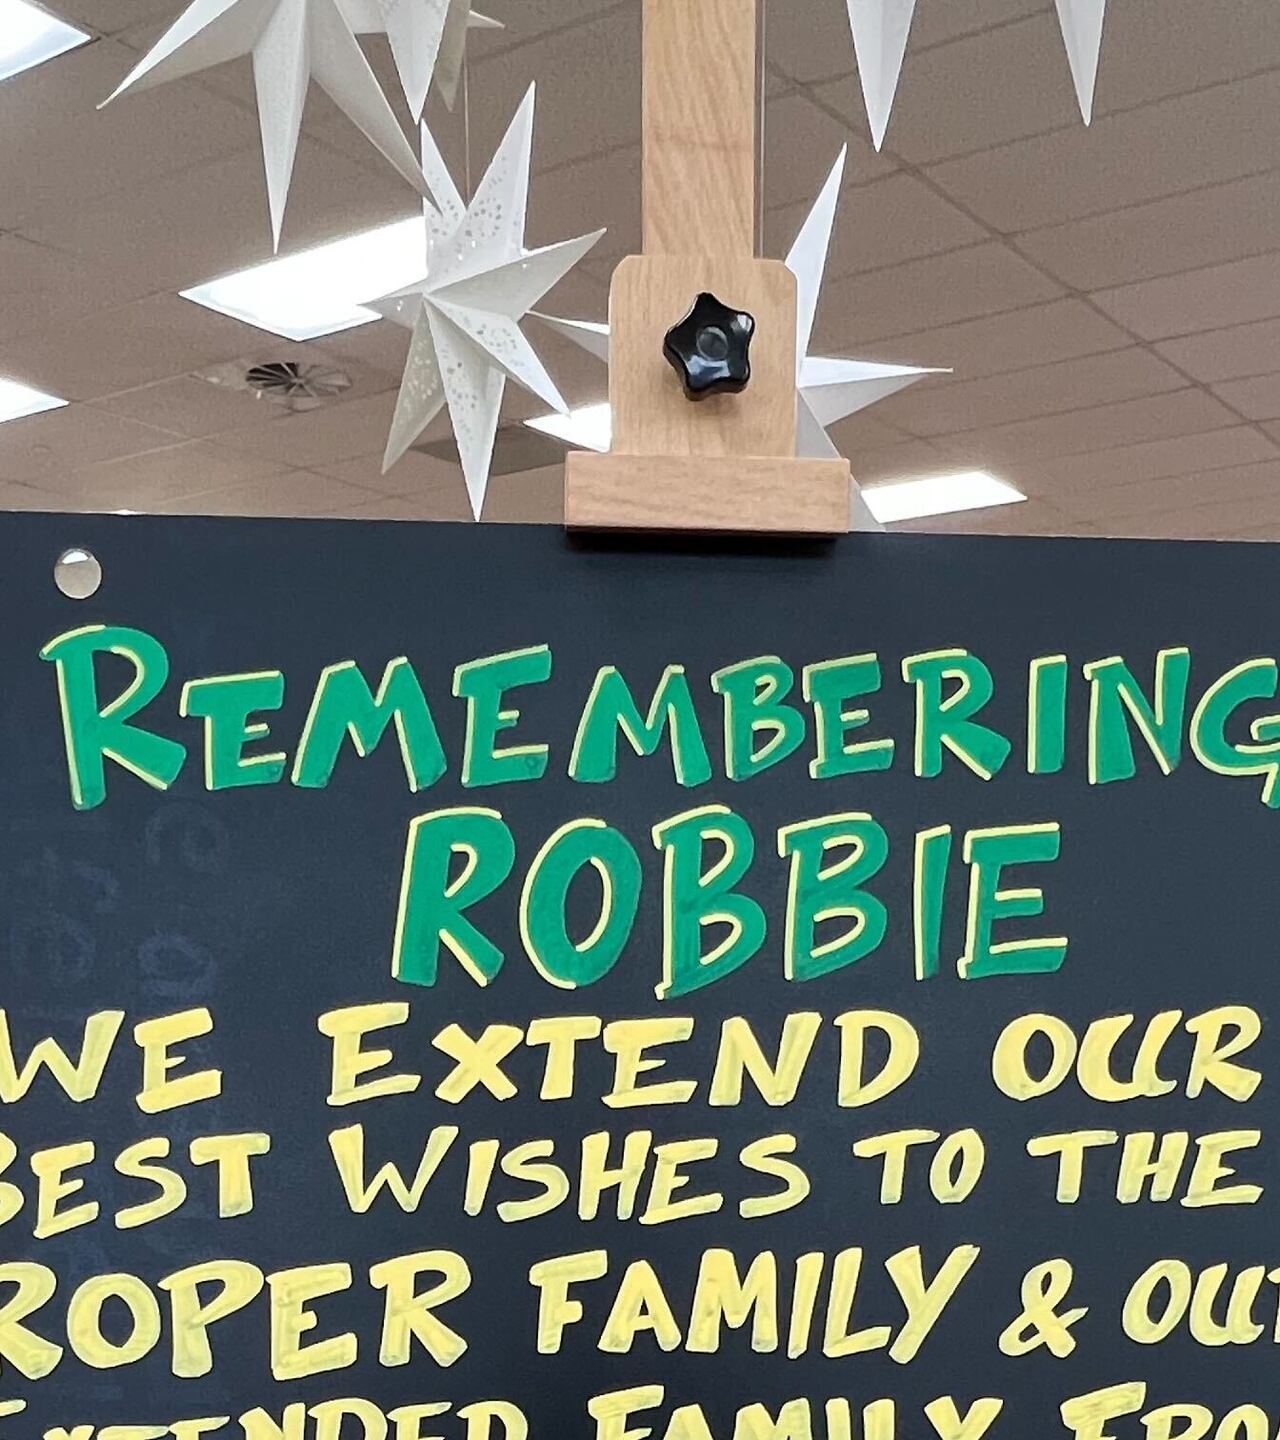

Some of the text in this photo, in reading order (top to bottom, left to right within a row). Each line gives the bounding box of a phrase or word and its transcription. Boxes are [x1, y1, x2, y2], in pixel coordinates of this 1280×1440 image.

[391, 803, 1068, 999] ROBBIE
[318, 1002, 920, 1108] EXTEND
[992, 1005, 1262, 1102] OUR
[329, 1123, 810, 1224] WISHES
[853, 1128, 985, 1203] TO
[1027, 1130, 1263, 1207] THE
[529, 1244, 980, 1364] FAMILY
[999, 1258, 1088, 1358] &
